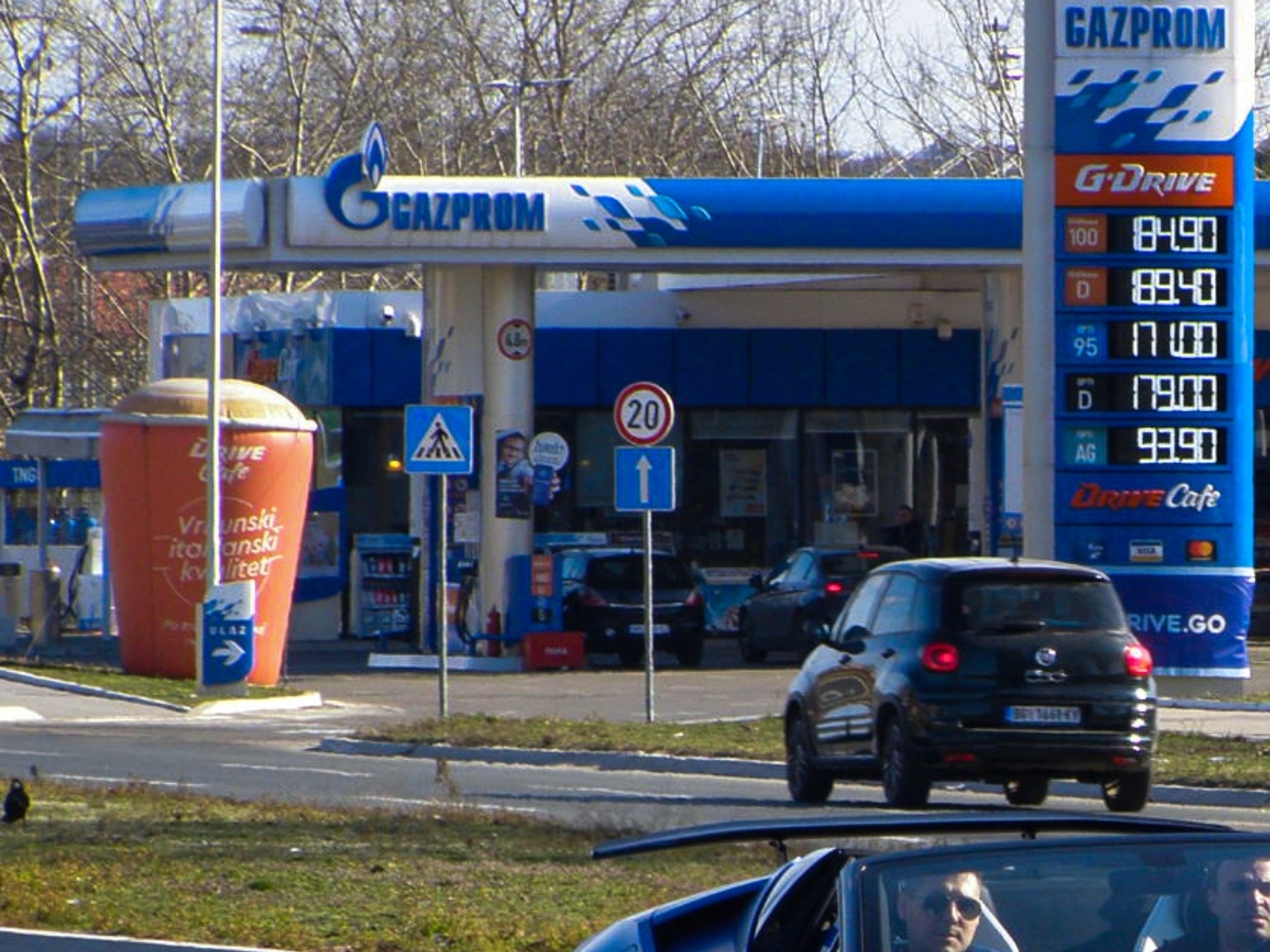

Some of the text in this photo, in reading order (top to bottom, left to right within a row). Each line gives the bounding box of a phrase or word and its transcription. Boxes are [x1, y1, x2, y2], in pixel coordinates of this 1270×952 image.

[1065, 6, 1226, 48] GAZPROM
[392, 192, 545, 232] GAZPROM
[1069, 227, 1098, 246] 100
[1076, 280, 1091, 299] D
[1074, 337, 1098, 357] 95
[1078, 389, 1093, 410] D
[628, 399, 660, 430] 20
[1138, 427, 1217, 464] 93.90
[1166, 482, 1221, 512] Cafe
[179, 507, 278, 535] Vrunski
[181, 555, 272, 581] kvlitet
